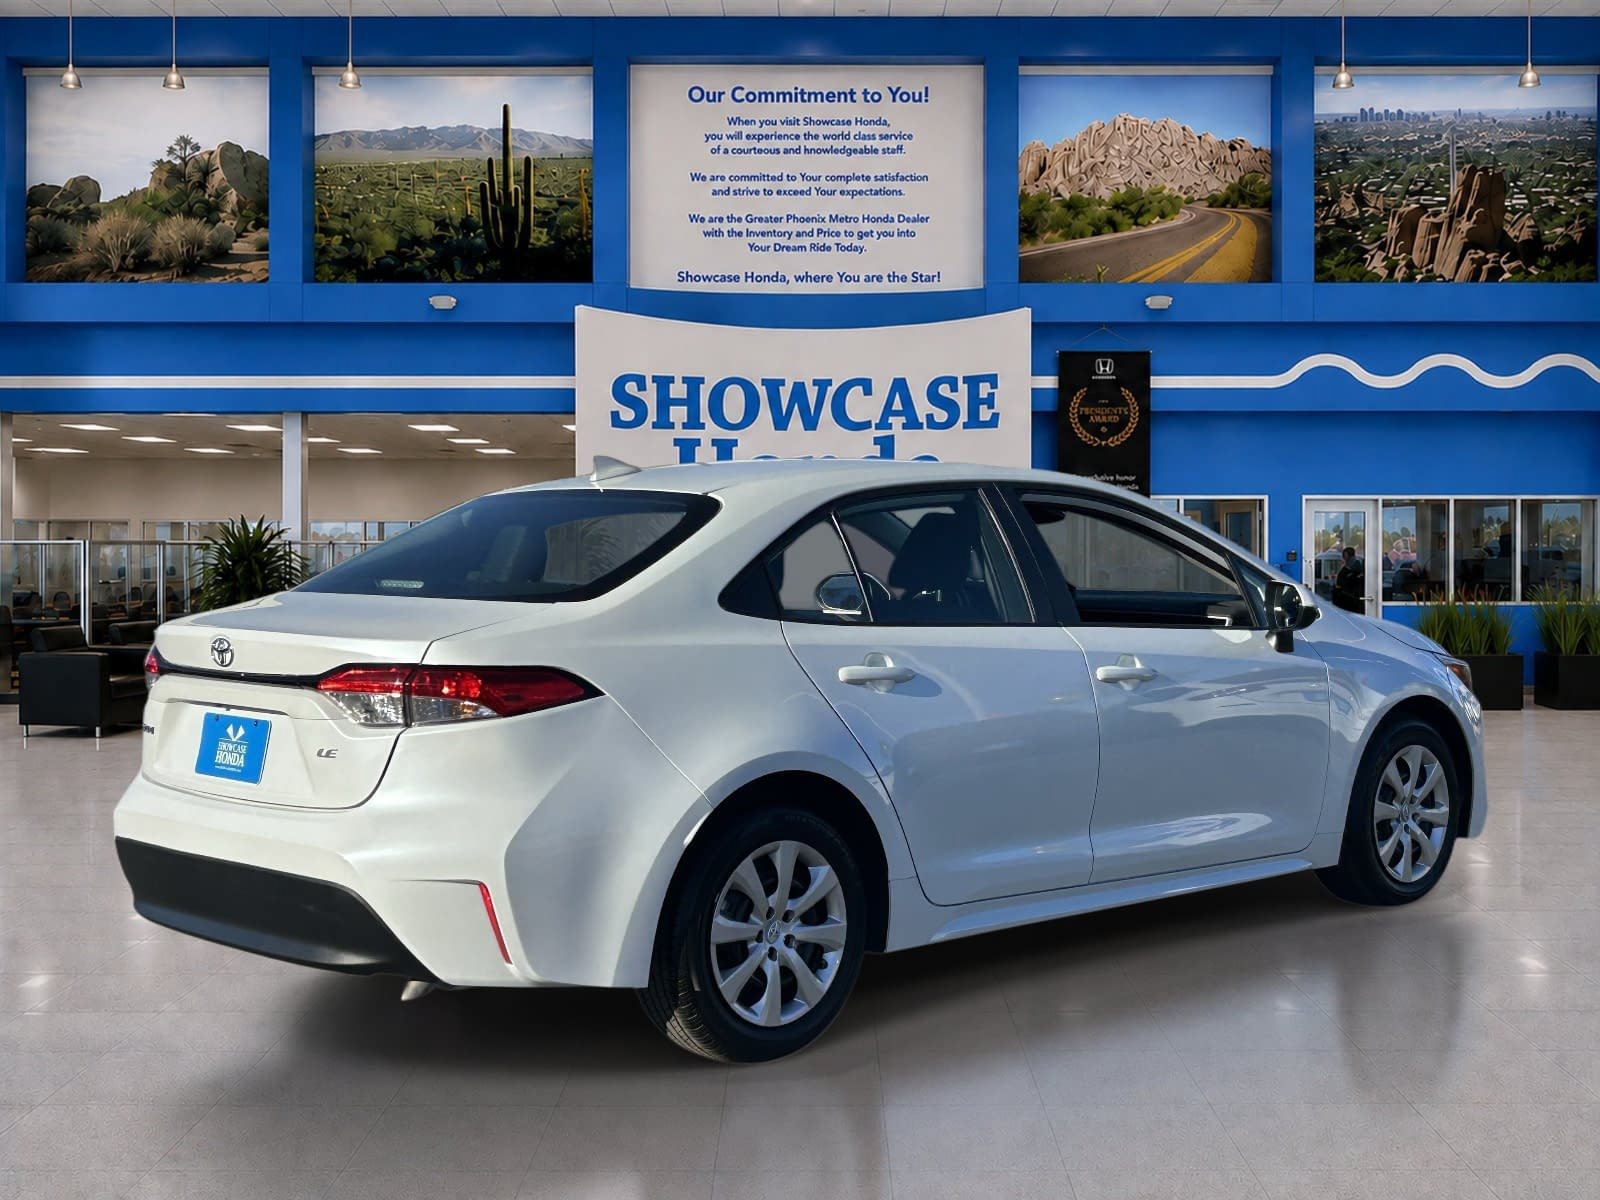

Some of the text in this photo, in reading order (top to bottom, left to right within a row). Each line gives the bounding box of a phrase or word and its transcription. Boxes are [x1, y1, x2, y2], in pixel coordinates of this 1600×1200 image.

[688, 86, 929, 103] Our Commitment to You!
[727, 116, 890, 128] When you visit Showcase Honda,
[705, 131, 913, 143] you will experience the world class service
[710, 145, 722, 154] of
[731, 146, 780, 154] courteous
[783, 145, 801, 154] and
[882, 145, 905, 154] staff.
[690, 173, 707, 182] We
[729, 172, 783, 182] committed
[786, 174, 797, 182] to
[800, 173, 822, 182] Your
[825, 173, 871, 184] complete
[874, 172, 928, 182] satisfaction
[712, 187, 905, 199] and strive to exceed Your expectations.
[689, 214, 705, 223] We
[726, 214, 742, 223] the
[745, 214, 784, 223] Greater
[786, 214, 826, 223] Phoenix
[829, 214, 859, 223] Metro
[862, 214, 894, 223] Honda
[898, 214, 930, 223] Dealer
[703, 228, 724, 237] with
[727, 228, 743, 237] the
[746, 228, 793, 240] Inventory
[795, 228, 814, 238] and
[817, 228, 841, 237] Price
[857, 230, 874, 240] get
[877, 231, 894, 240] you
[897, 228, 916, 237] into
[748, 243, 866, 254] Your Dream Ride Today.
[678, 271, 940, 285] Showcase Honda, where You are the Star!
[609, 372, 1001, 431] SHOWCASE
[1115, 473, 1136, 481] honor
[217, 741, 248, 754] SHOWCASE
[317, 748, 339, 759] LE
[215, 750, 245, 767] HONDA
